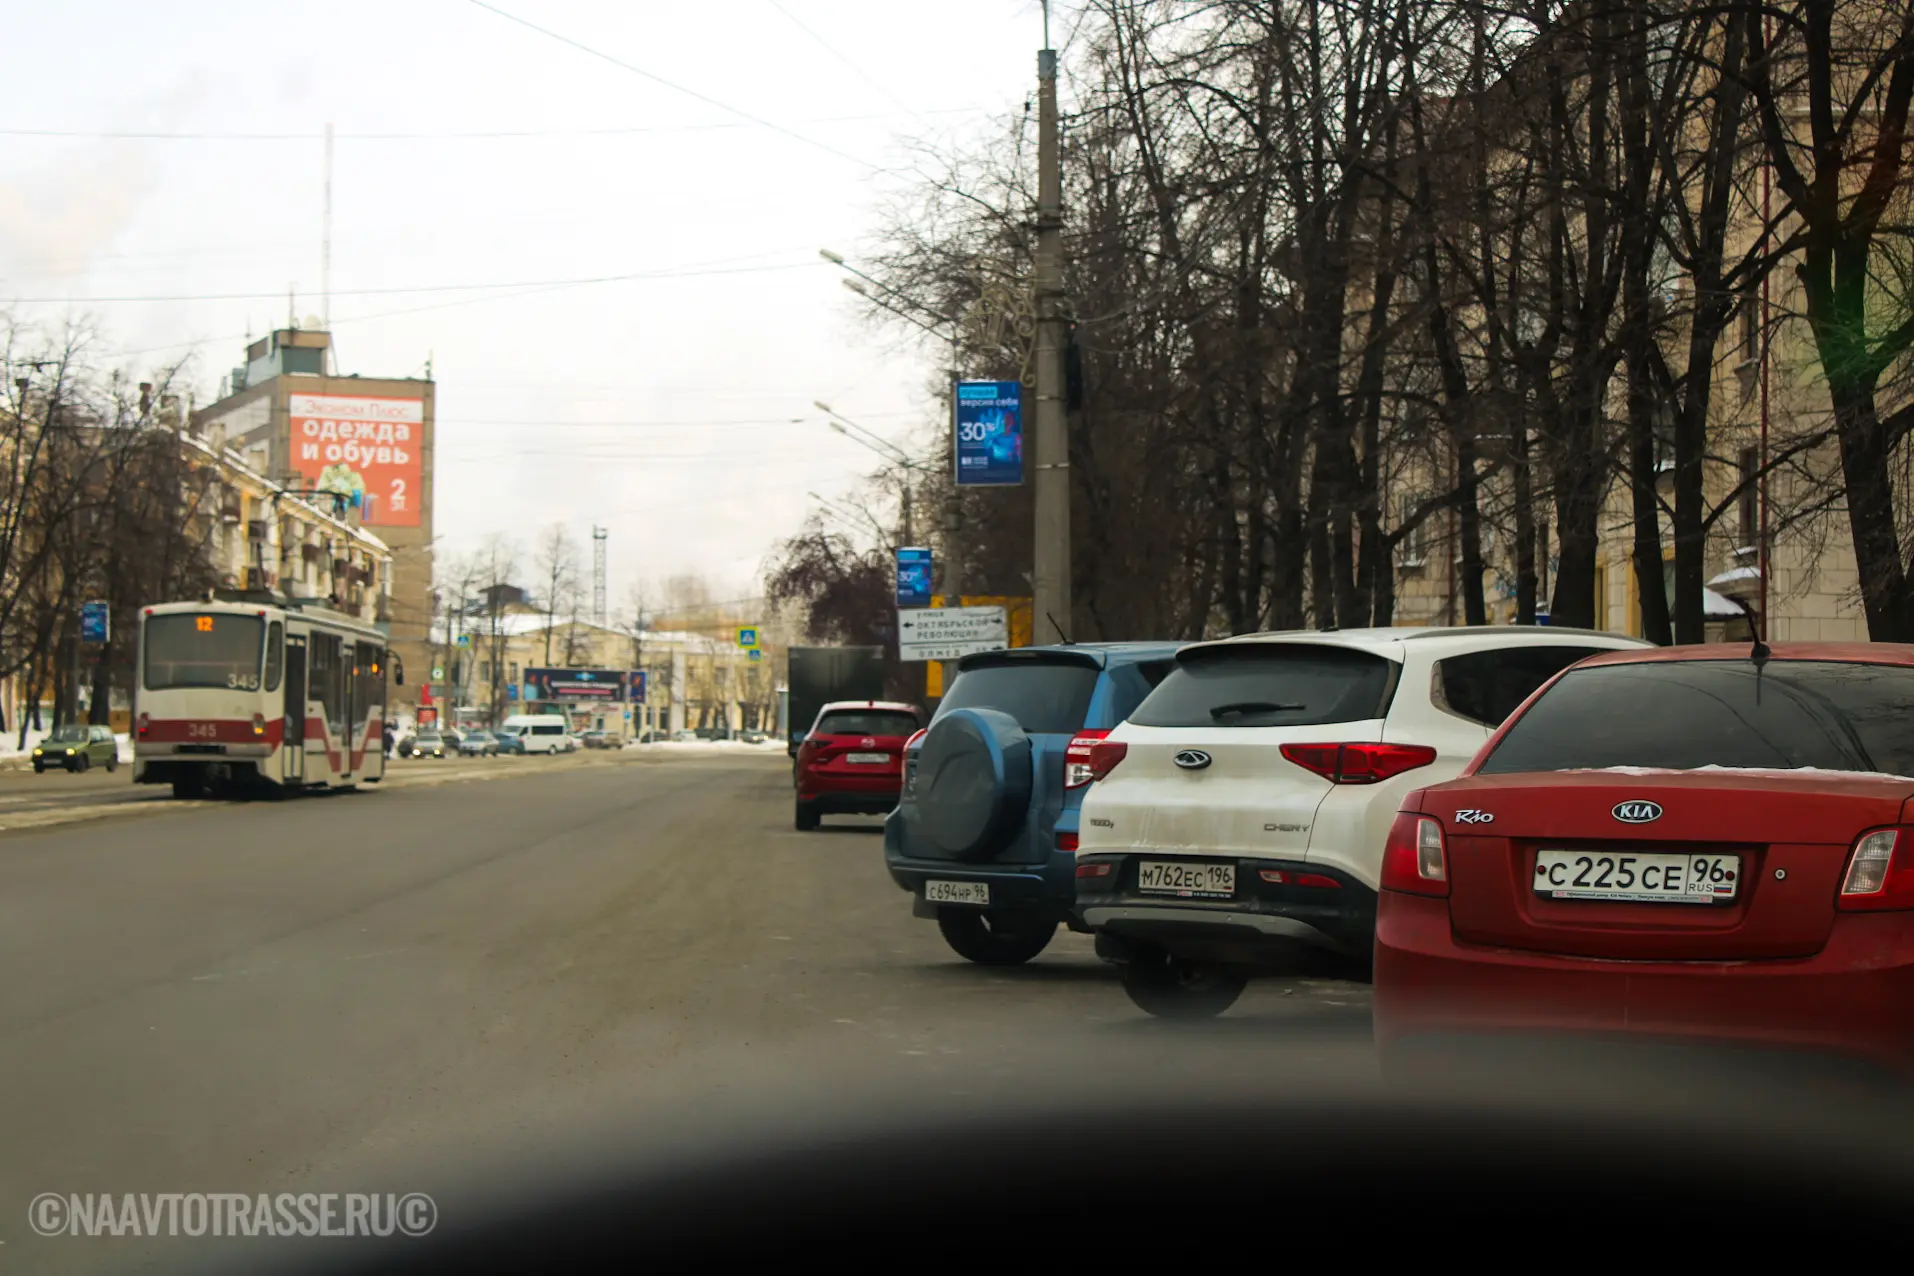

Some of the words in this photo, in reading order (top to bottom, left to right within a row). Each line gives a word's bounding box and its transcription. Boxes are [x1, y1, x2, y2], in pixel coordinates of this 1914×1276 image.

[302, 419, 410, 444] одежда
[302, 443, 319, 460] и
[325, 440, 409, 469] обувь
[390, 478, 406, 500] 2
[196, 616, 214, 631] 12
[227, 673, 259, 689] 345
[188, 724, 217, 738] 345
[1455, 809, 1494, 824] Rio
[1619, 805, 1654, 818] KIA
[1263, 823, 1310, 832] CHERY
[1688, 883, 1713, 893] RUS
